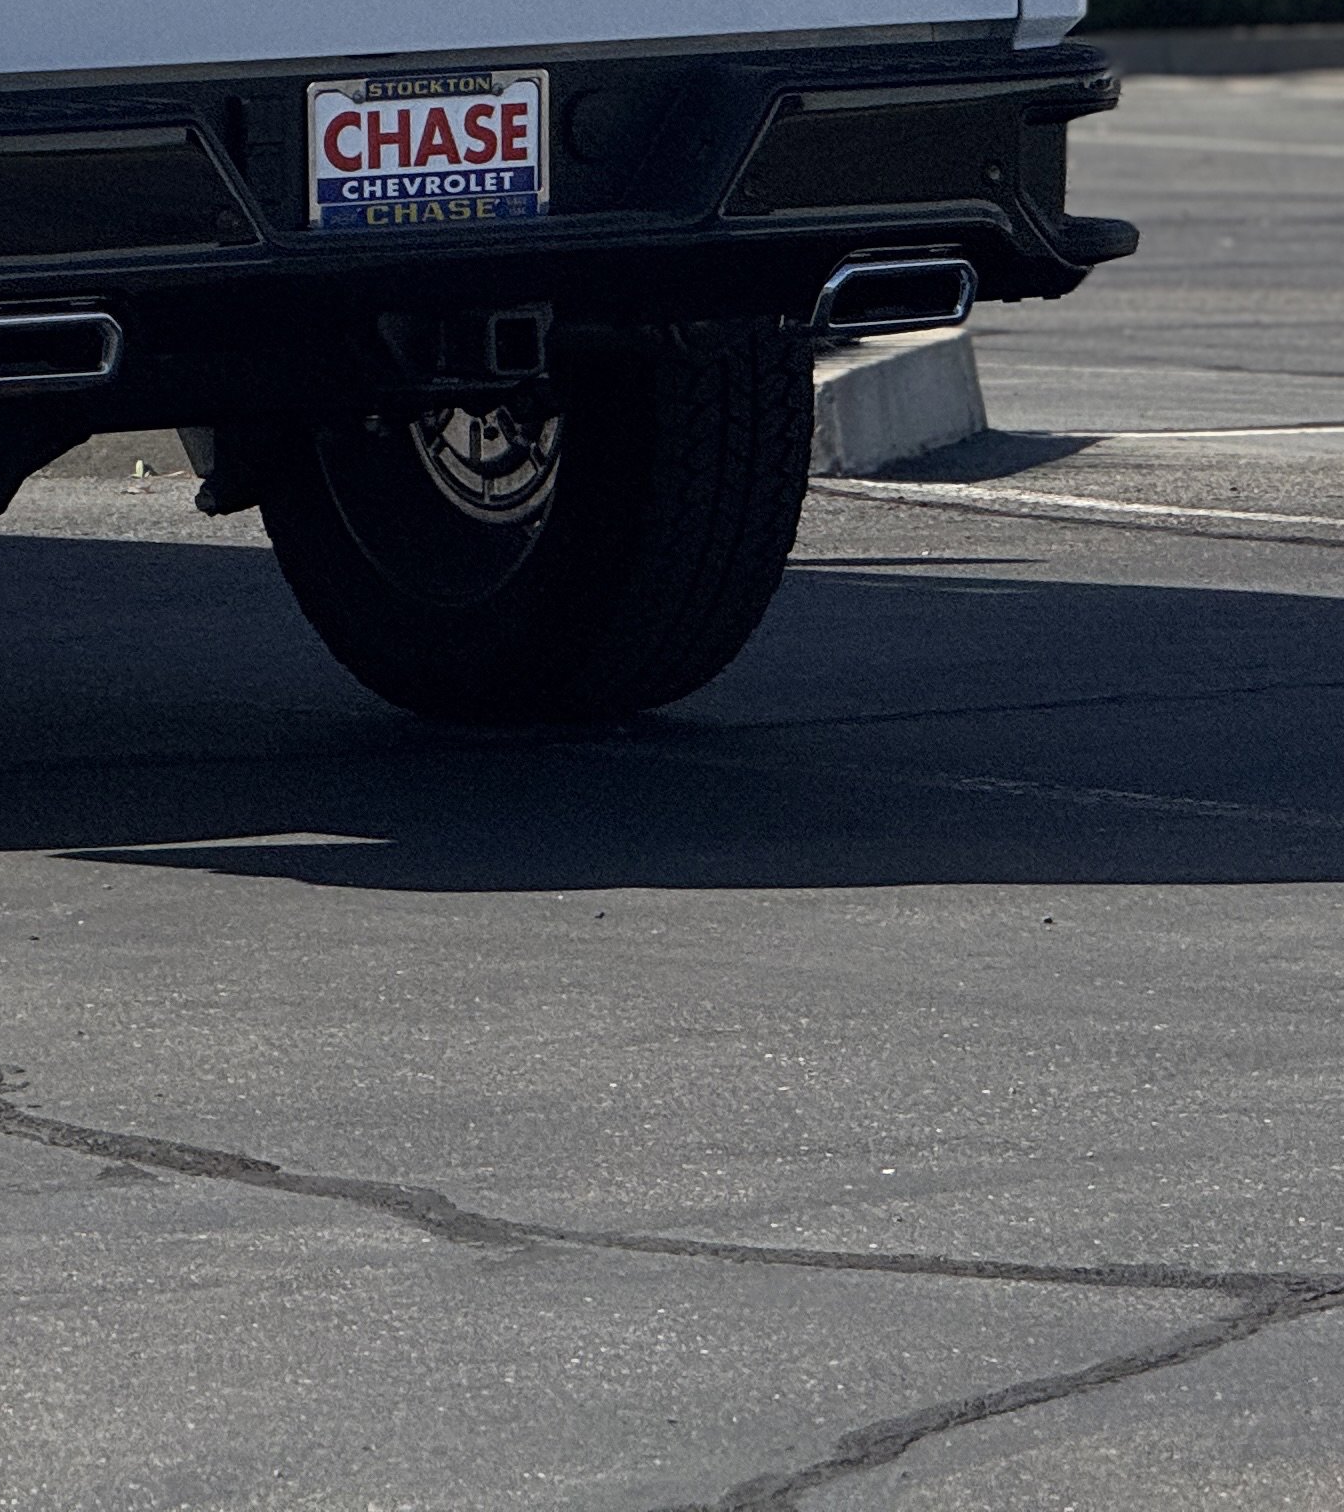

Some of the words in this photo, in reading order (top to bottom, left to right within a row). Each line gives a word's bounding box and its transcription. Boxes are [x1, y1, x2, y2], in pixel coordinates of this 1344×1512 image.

[368, 76, 492, 98] STOCKTON
[324, 102, 528, 172] CHASE
[342, 172, 514, 200] CHEVROLET
